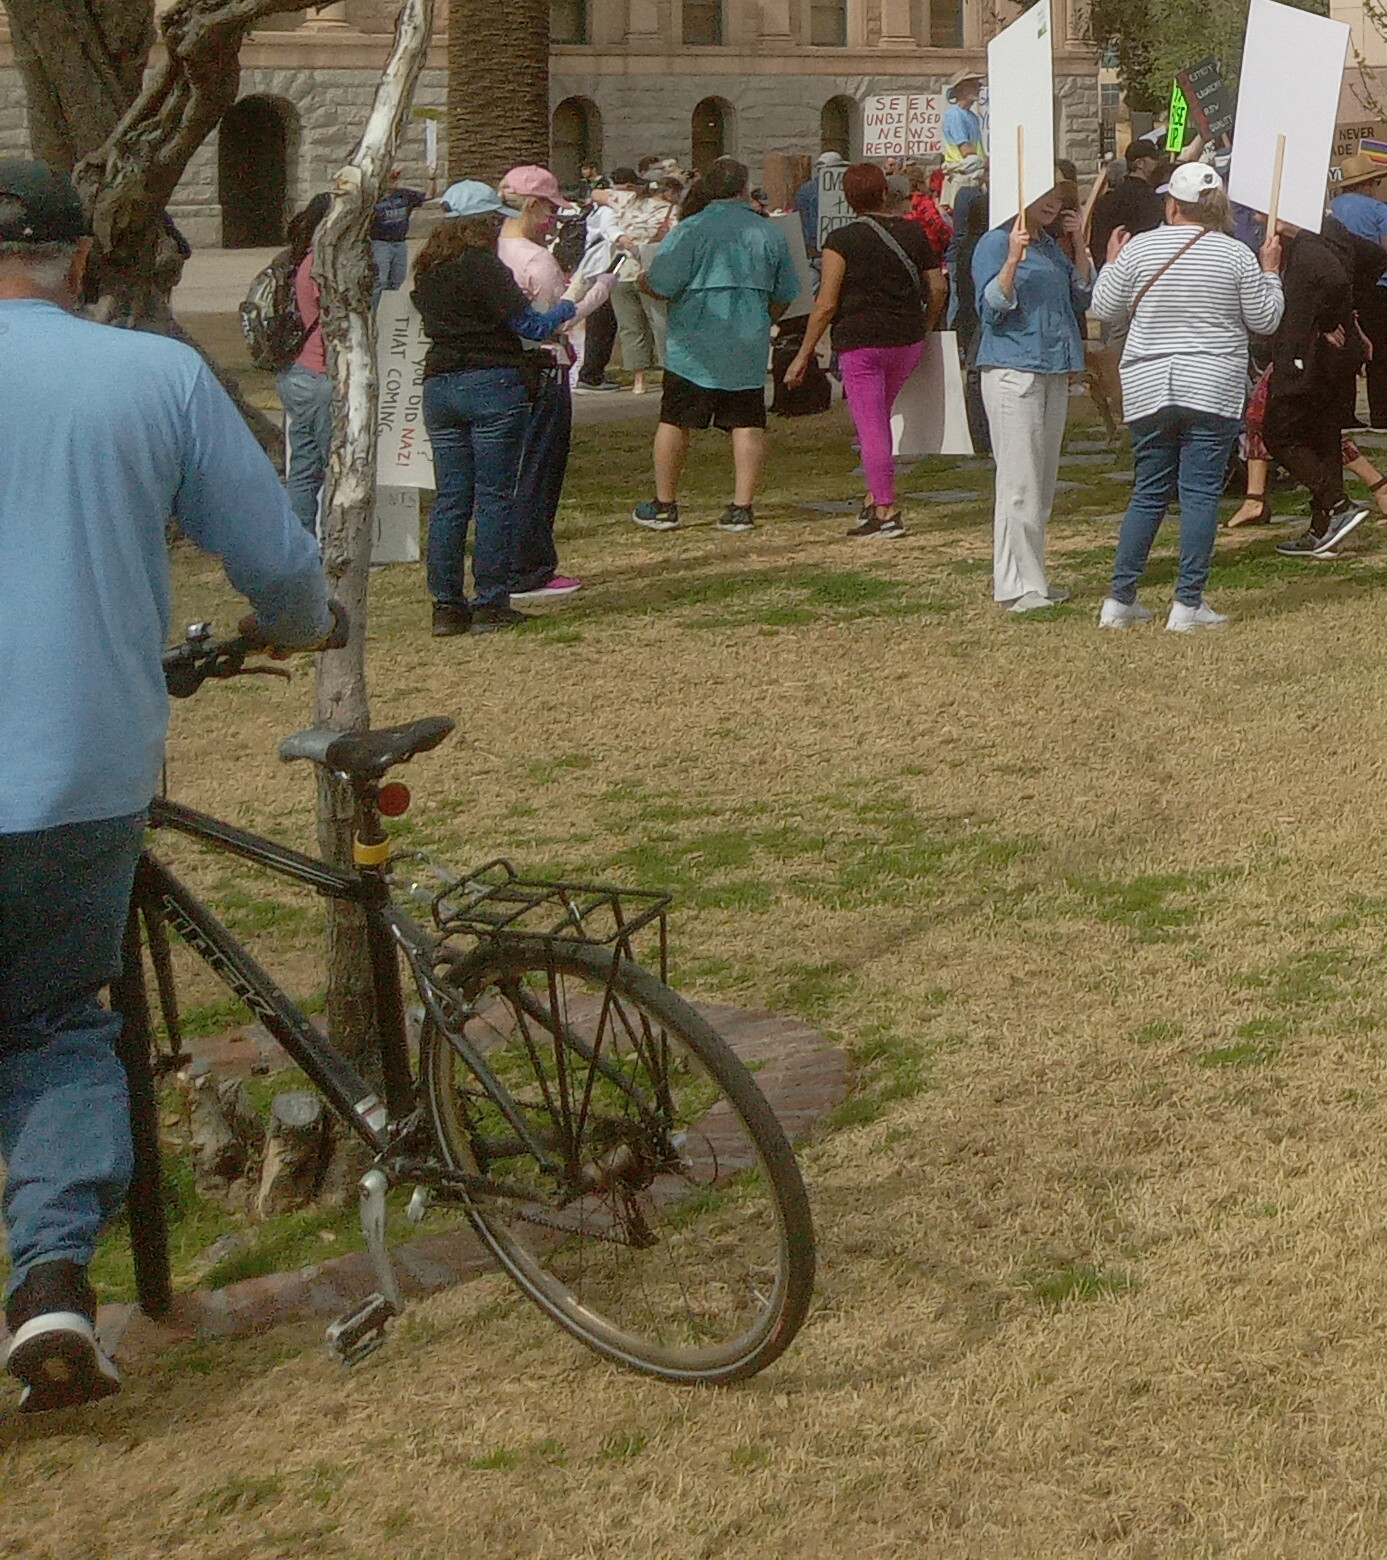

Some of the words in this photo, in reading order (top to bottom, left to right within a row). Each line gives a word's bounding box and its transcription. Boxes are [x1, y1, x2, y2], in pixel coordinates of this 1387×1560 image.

[875, 97, 936, 111] SEEK
[866, 112, 941, 126] UNBIASED
[877, 126, 937, 140] NEWS
[1339, 127, 1375, 140] NEVER
[865, 140, 942, 156] REPORTING
[393, 316, 411, 359] THAT
[404, 395, 422, 423] DID
[395, 427, 415, 467] NAZI
